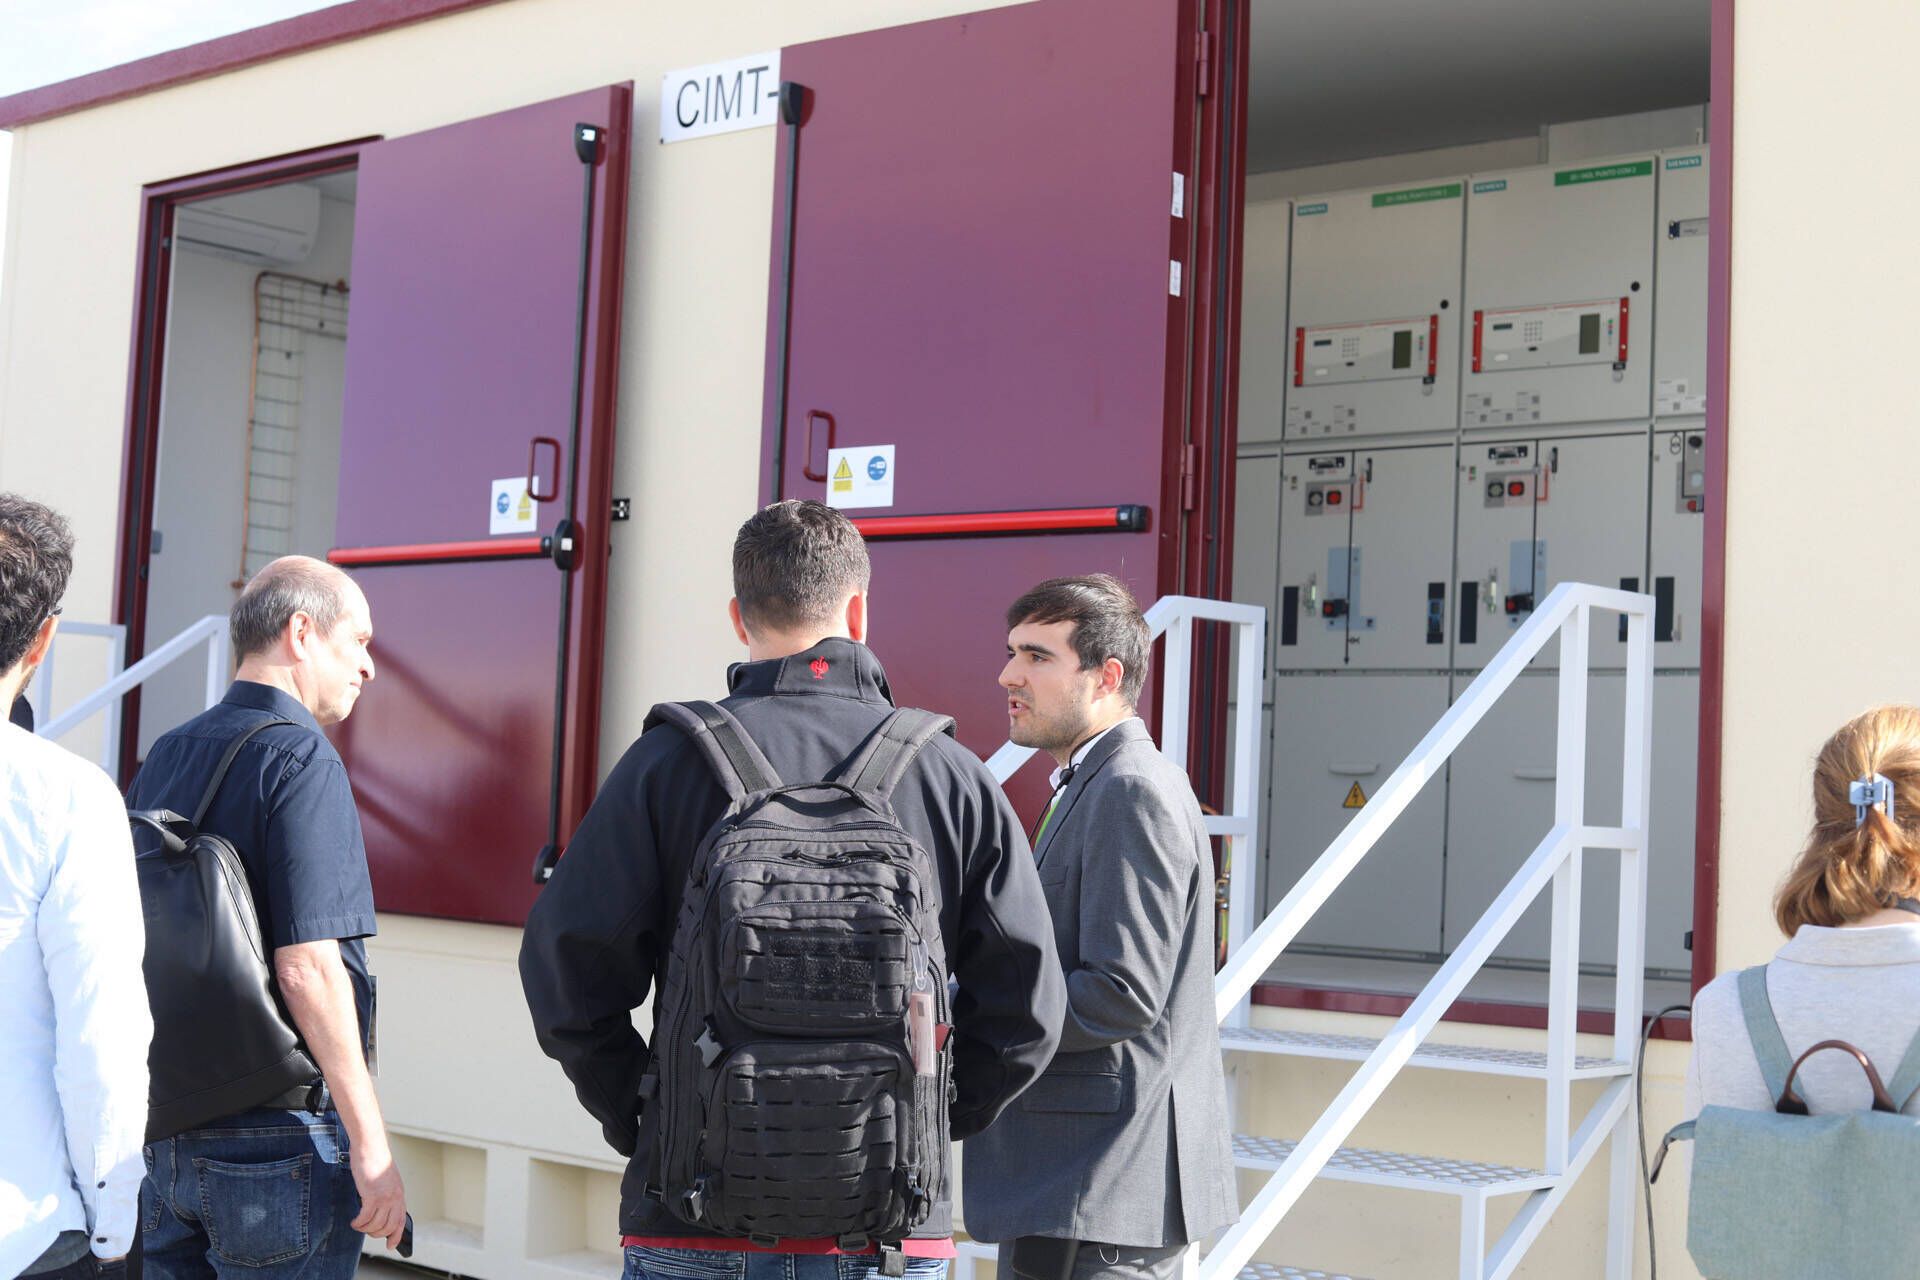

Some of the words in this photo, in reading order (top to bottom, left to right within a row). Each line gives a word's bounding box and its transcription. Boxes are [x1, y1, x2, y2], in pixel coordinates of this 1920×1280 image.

[677, 65, 779, 128] CIMT-
[1667, 158, 1700, 168] SIEMENS
[1475, 182, 1505, 192] SIEMENS
